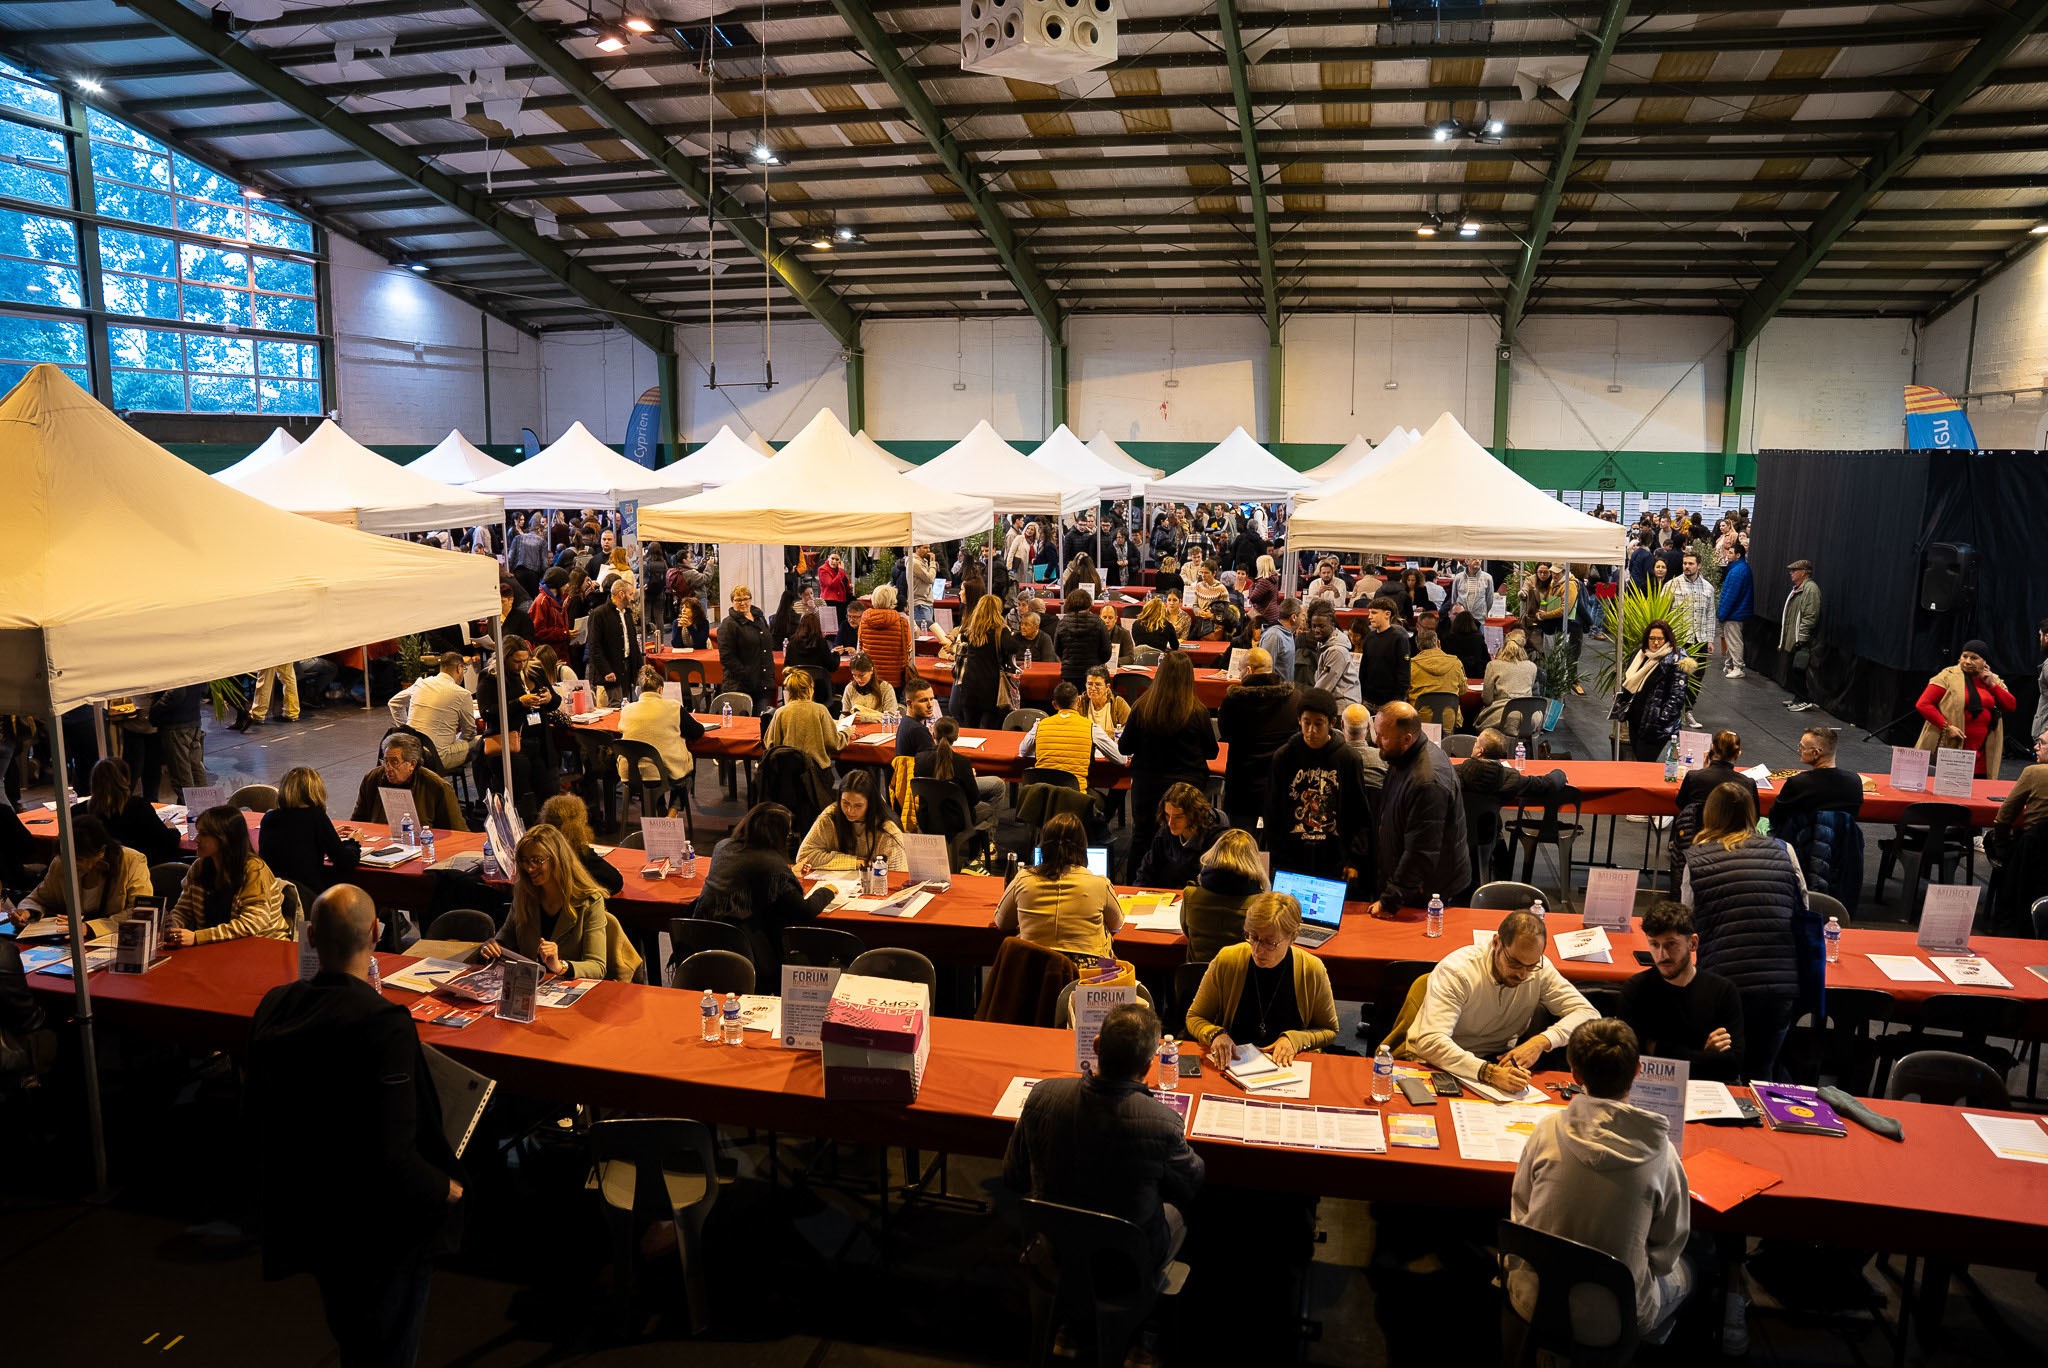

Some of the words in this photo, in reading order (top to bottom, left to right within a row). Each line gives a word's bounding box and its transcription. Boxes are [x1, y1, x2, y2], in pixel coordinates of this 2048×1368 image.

[633, 412, 649, 463] -Cyprien
[1725, 476, 1734, 487] E
[792, 970, 829, 982] FORUM
[867, 998, 878, 1006] 3
[1086, 991, 1125, 1002] FORUM
[835, 999, 917, 1016] FABRIANO
[880, 999, 919, 1008] COPY
[1640, 1061, 1675, 1077] ORUM
